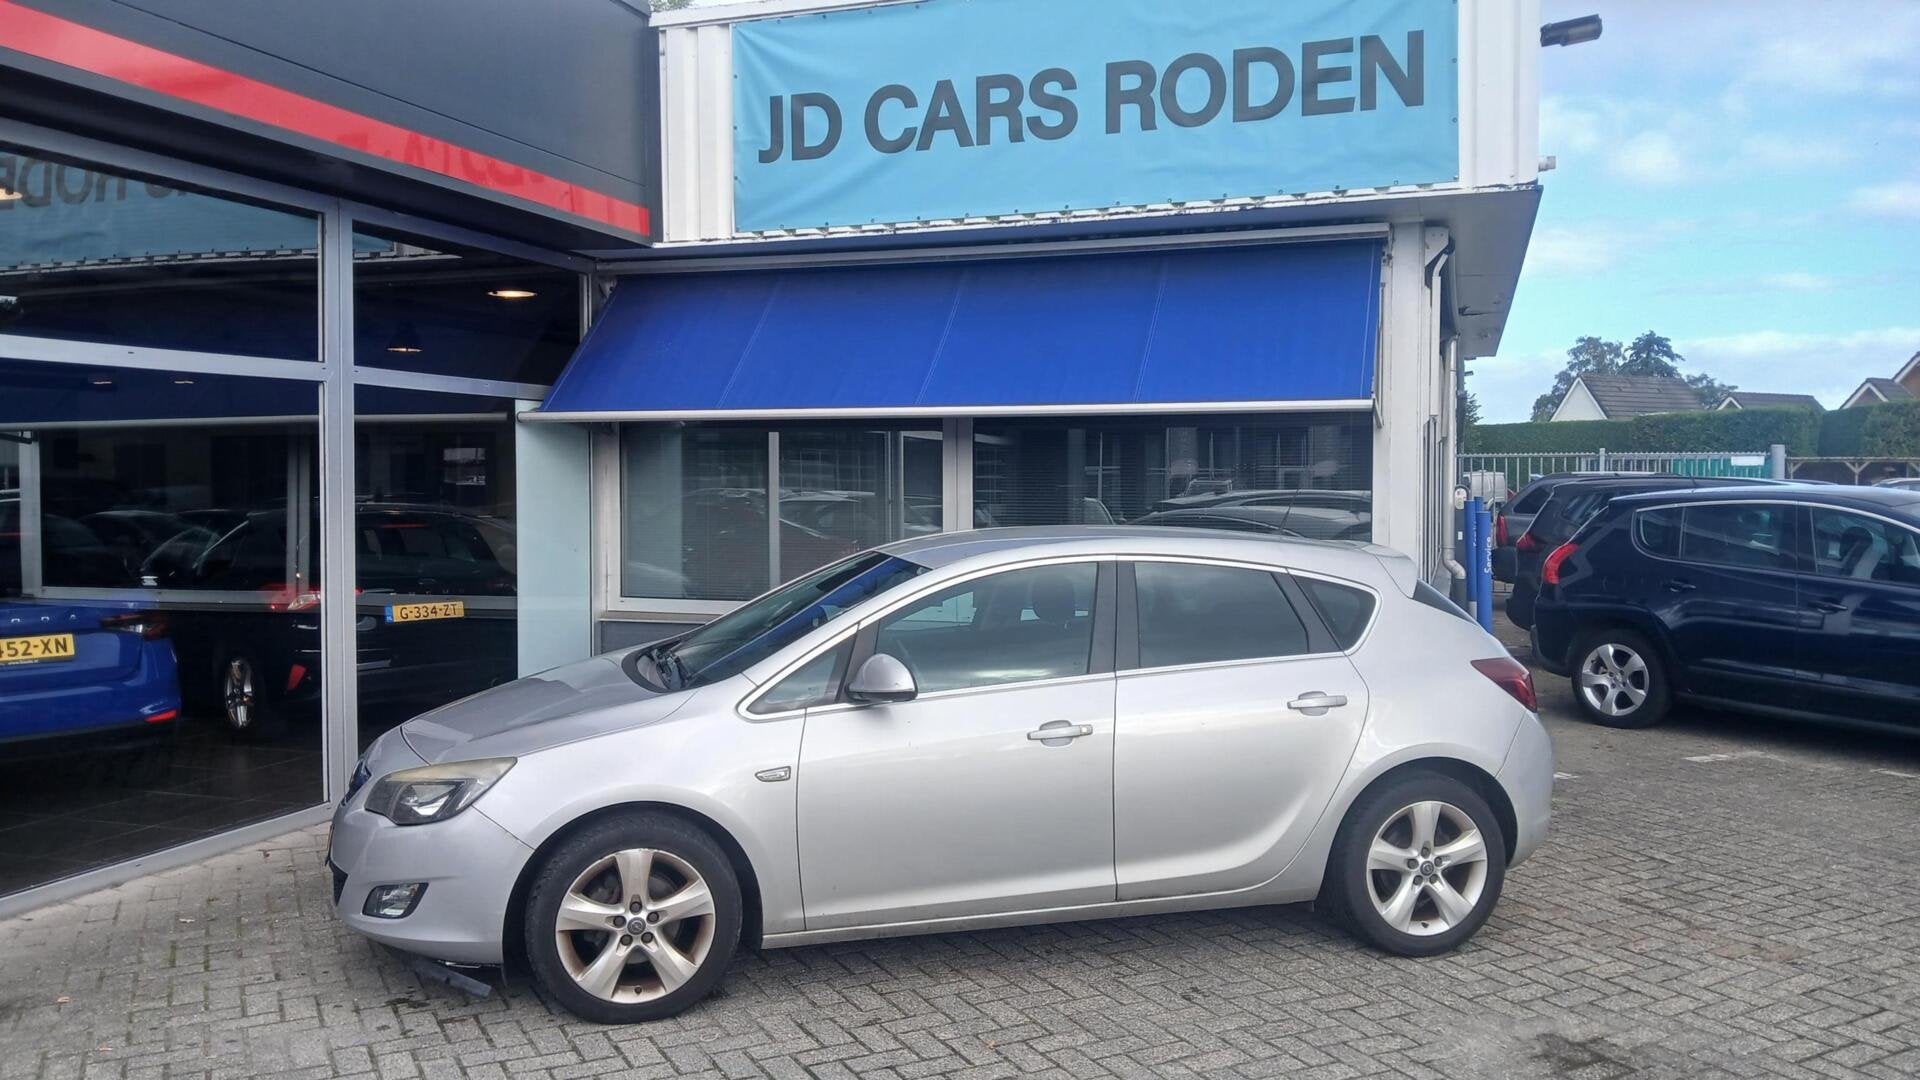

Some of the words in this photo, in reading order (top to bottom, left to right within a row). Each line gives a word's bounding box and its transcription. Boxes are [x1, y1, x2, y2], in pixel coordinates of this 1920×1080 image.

[758, 92, 843, 164] JD
[863, 67, 1078, 154] CARS
[1105, 30, 1424, 135] RODEN
[1484, 536, 1492, 574] Service
[399, 603, 458, 620] G-334-ZT
